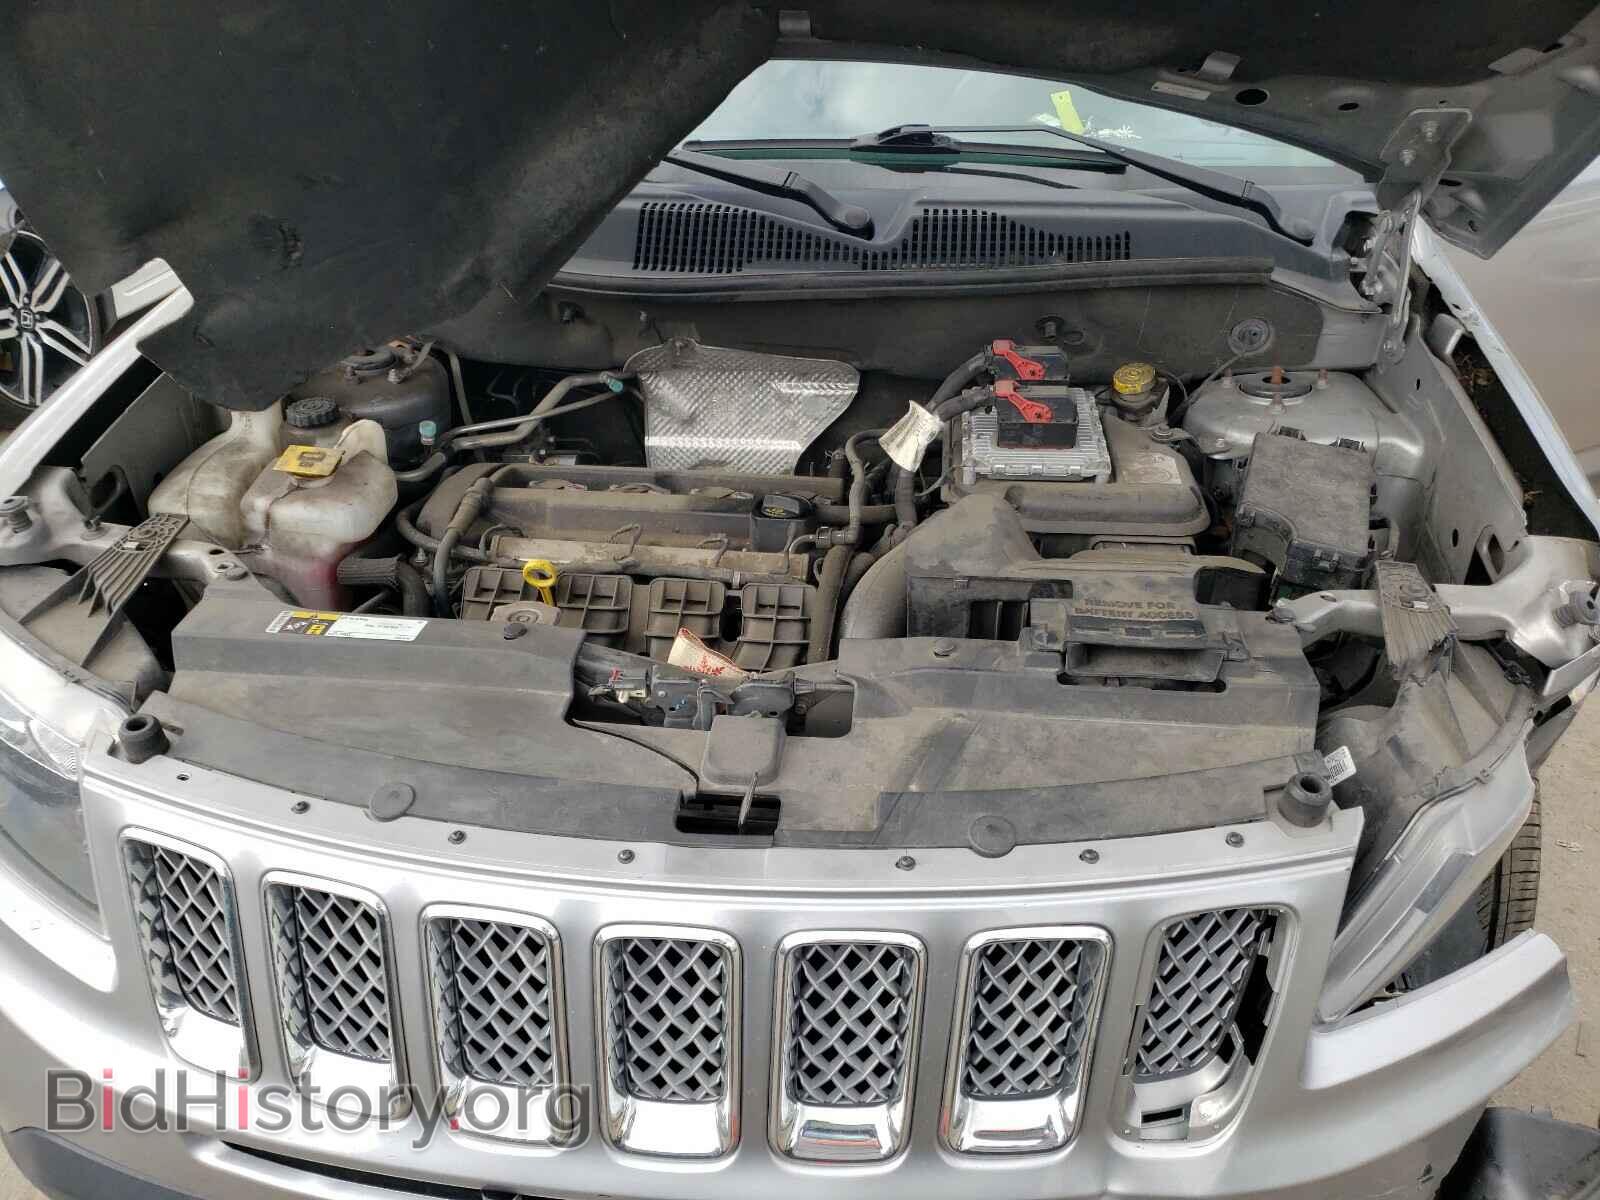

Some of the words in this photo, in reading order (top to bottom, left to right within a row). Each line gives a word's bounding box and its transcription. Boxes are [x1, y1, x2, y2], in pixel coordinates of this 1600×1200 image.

[1085, 598, 1143, 609] REMOVE
[1146, 601, 1177, 609] FOR
[1138, 610, 1195, 620] ACCESS
